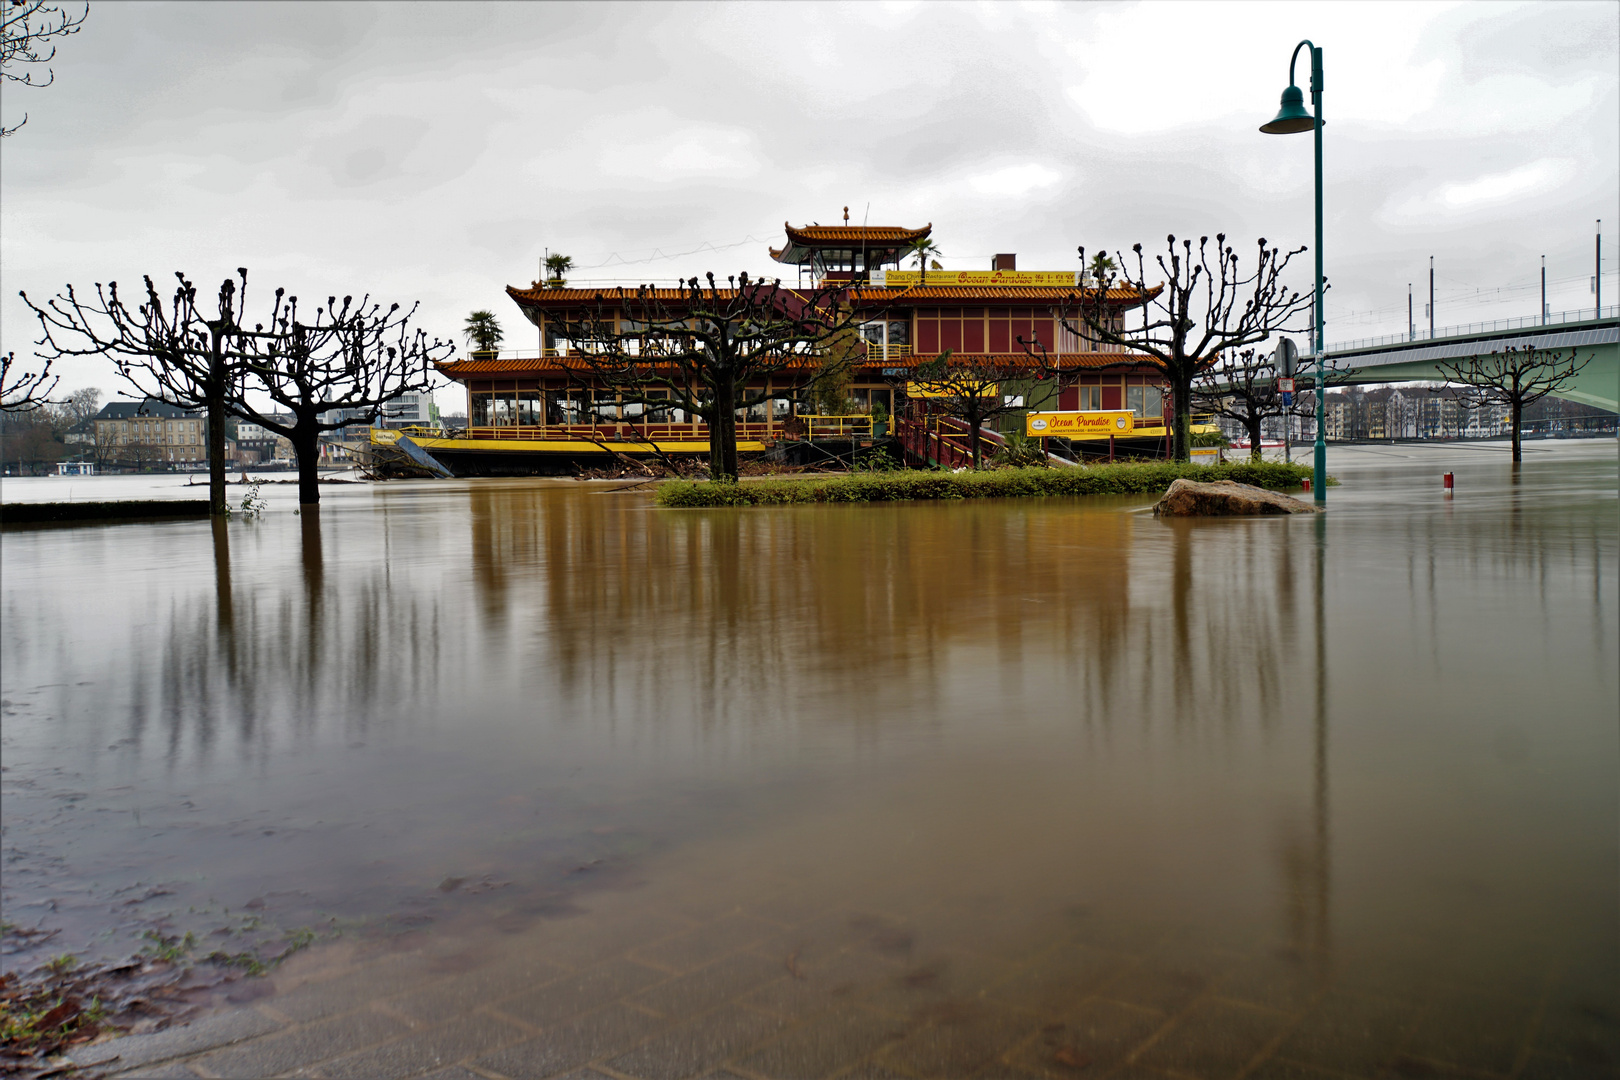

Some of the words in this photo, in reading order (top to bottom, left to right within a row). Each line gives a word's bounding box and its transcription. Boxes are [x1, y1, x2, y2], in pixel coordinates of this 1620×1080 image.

[958, 272, 989, 284] Ocean
[990, 272, 1033, 284] Paradise
[1050, 416, 1073, 428] Ocean
[1076, 416, 1110, 427] Paradise
